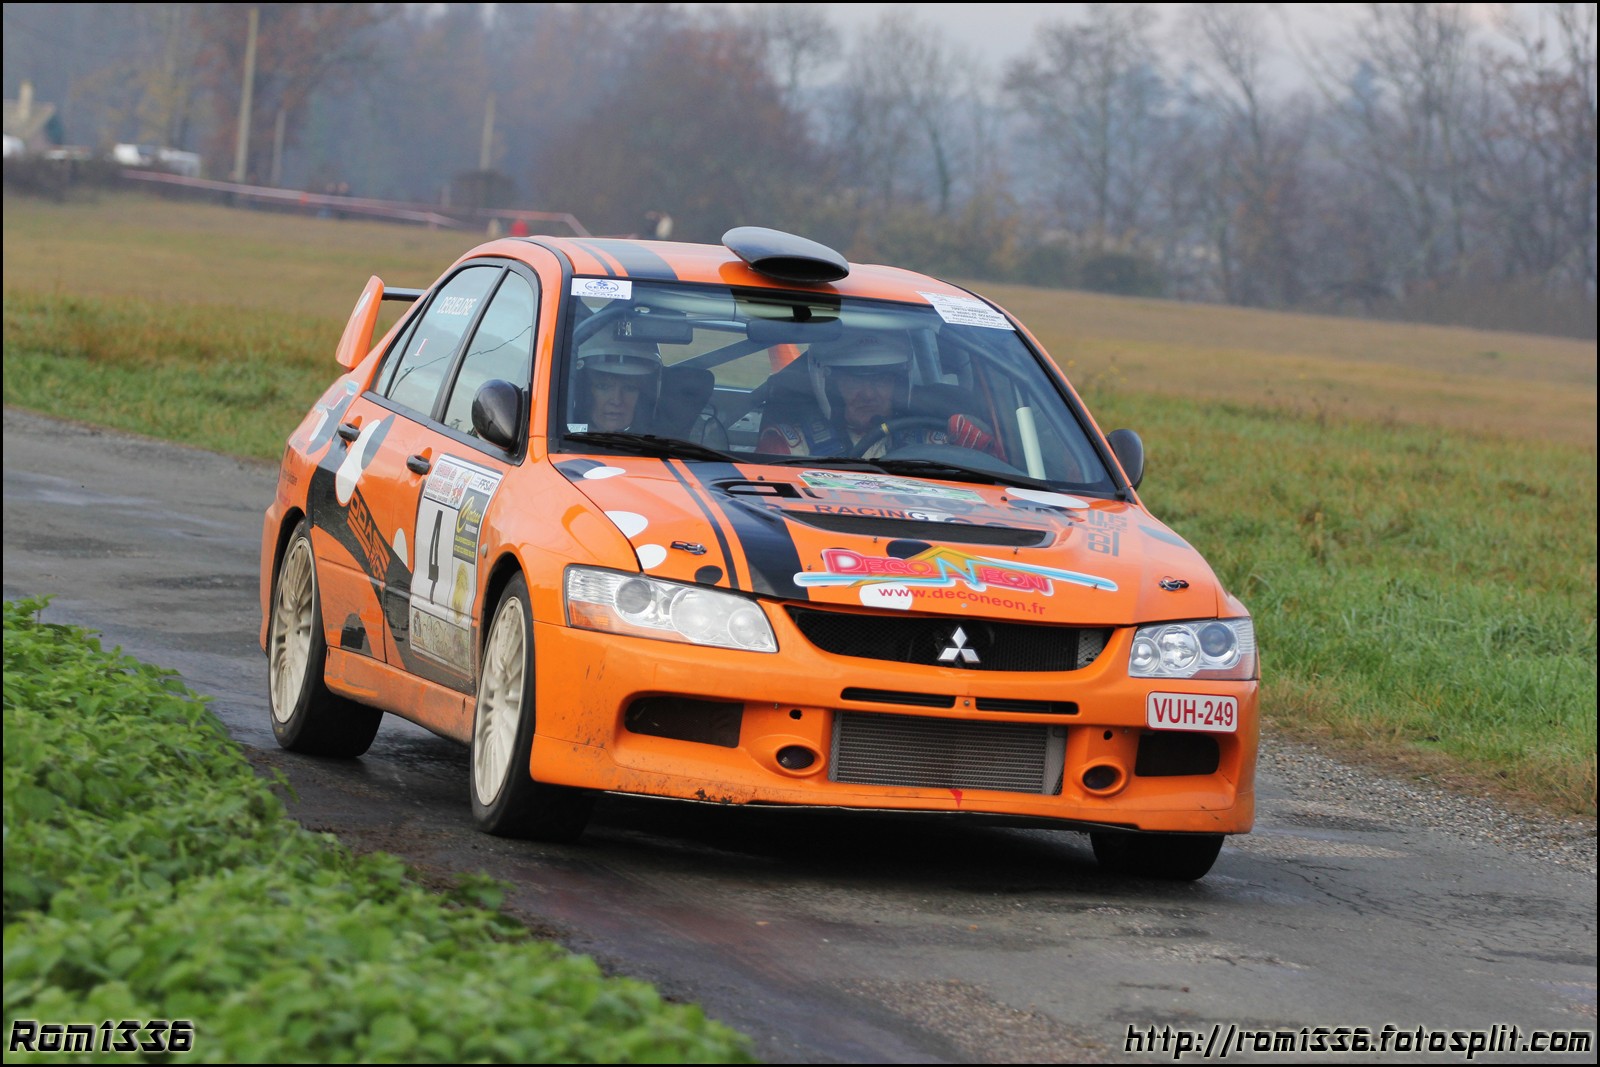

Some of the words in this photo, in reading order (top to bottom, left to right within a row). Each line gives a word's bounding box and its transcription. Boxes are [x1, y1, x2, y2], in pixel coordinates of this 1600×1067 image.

[814, 504, 928, 521] RACING
[428, 510, 443, 606] 4
[877, 586, 1046, 615] www.deconeon.fr
[1152, 697, 1234, 727] VUH-249
